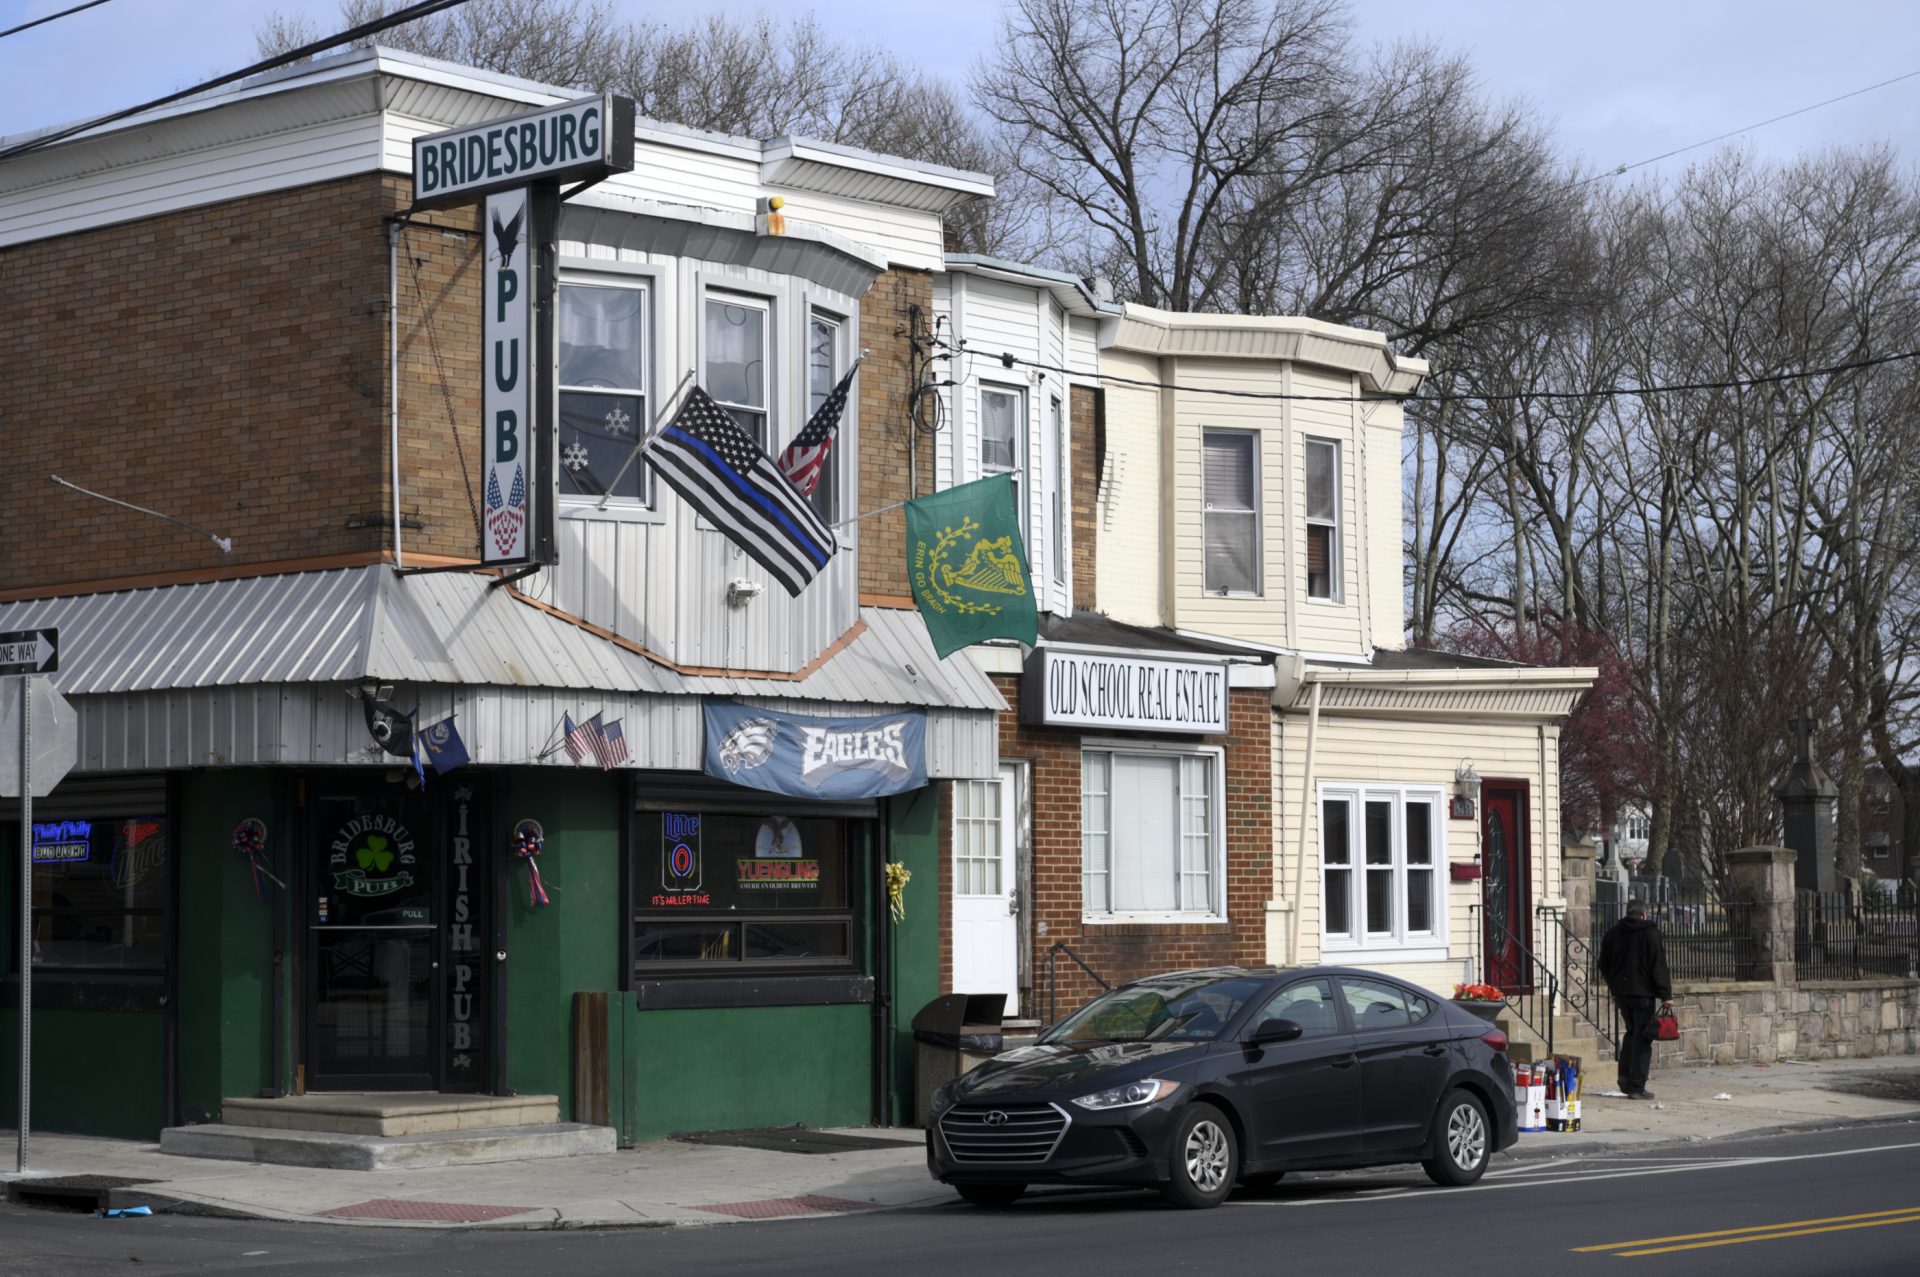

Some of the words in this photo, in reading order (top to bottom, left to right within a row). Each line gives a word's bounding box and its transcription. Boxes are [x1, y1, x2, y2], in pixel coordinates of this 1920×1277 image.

[422, 107, 599, 193] BRIDESBURG
[495, 269, 519, 464] PUB
[915, 541, 927, 568] ERIN
[915, 572, 927, 588] GO
[921, 589, 947, 614] BRAGH
[18, 643, 37, 661] WAY
[1050, 658, 1077, 714] OLD
[1081, 661, 1134, 719] SCHOOL
[1138, 666, 1171, 721] REAL
[1175, 669, 1220, 724] ESTATE
[800, 720, 909, 777] EAGLES
[331, 814, 416, 865] BRIDESBURG
[665, 812, 699, 842] Lite
[34, 846, 55, 860] BUD
[56, 844, 86, 859] LIGHT
[451, 804, 473, 951] IRISH
[738, 861, 820, 880] YUENGLING
[353, 879, 399, 894] PUB
[652, 895, 665, 906] IT'S
[666, 895, 692, 905] MILLER
[693, 894, 710, 904] TIME
[402, 910, 423, 918] PULL
[453, 964, 472, 1050] PUB
